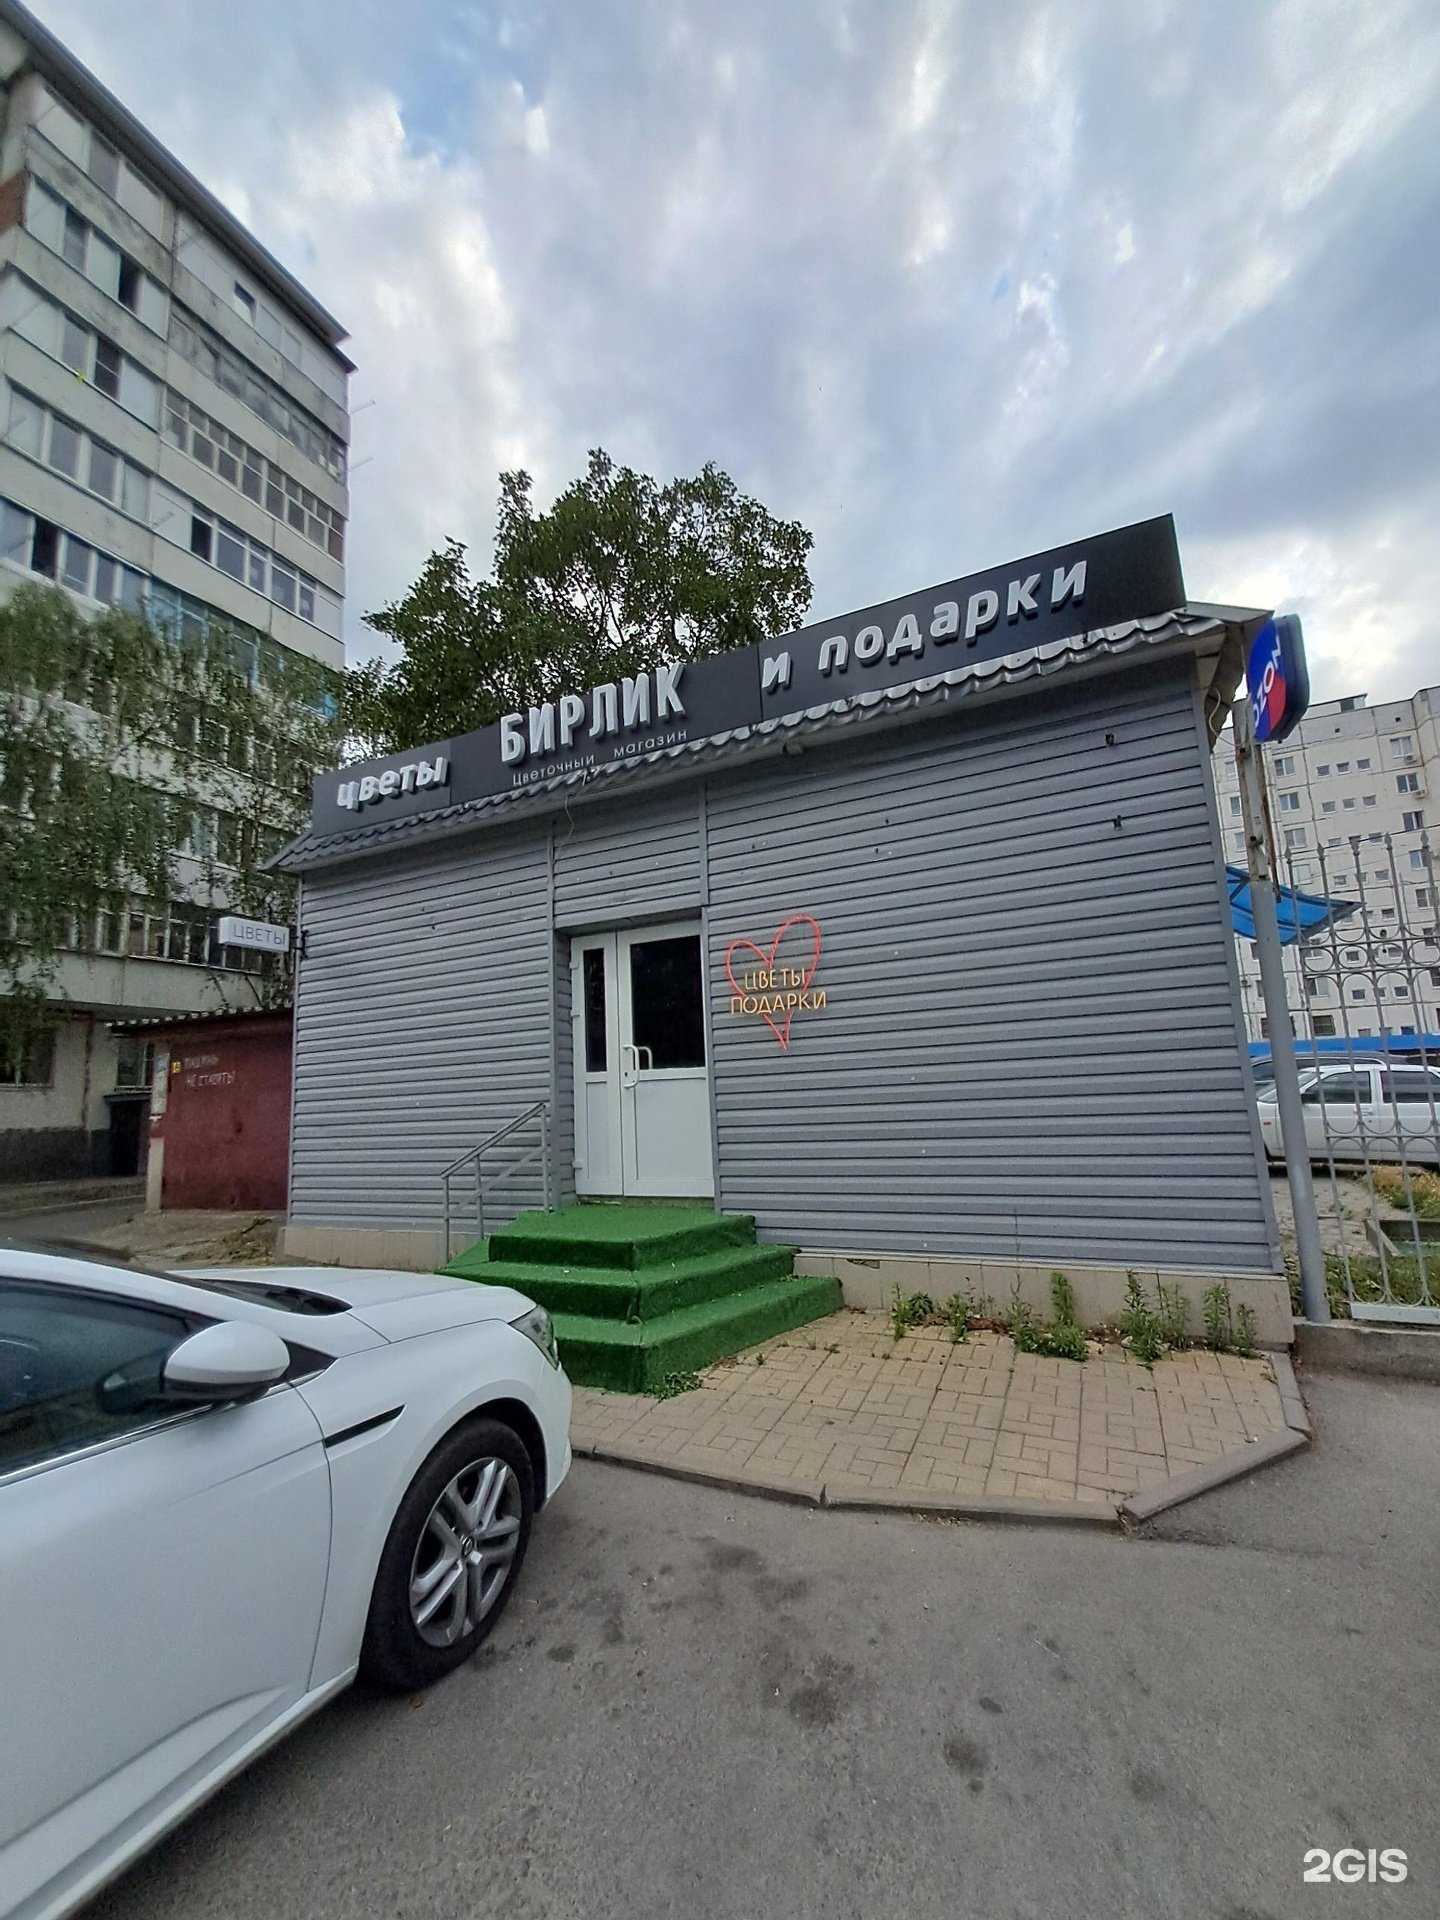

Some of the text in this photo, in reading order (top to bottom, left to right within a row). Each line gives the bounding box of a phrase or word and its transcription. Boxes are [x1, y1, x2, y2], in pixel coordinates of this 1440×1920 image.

[761, 560, 1087, 693] и подарки
[500, 663, 686, 766] БИРЛИК
[336, 756, 449, 812] цветы
[512, 729, 689, 787] Цветочный магазин
[233, 924, 286, 945] ЦВЕТЫ
[731, 991, 826, 1014] ПОДАРКИ
[744, 968, 806, 990] ЦВЕТЫ
